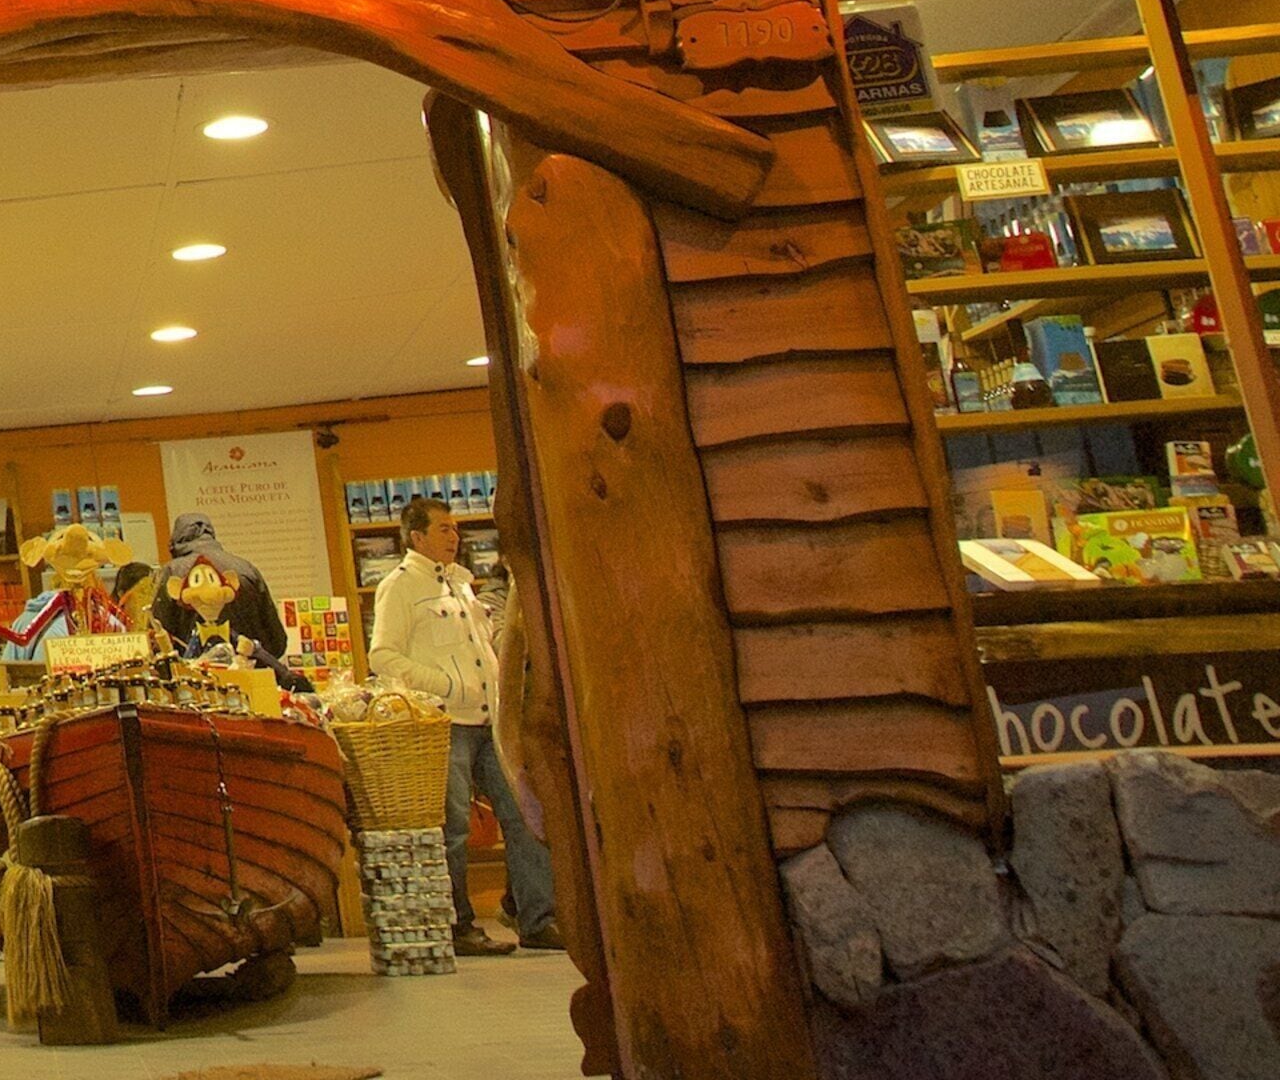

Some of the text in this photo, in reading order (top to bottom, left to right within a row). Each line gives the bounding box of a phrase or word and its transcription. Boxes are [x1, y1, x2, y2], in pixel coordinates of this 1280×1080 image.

[966, 164, 1036, 180] CHOCOLATE
[969, 177, 1040, 193] ARTESANAL
[197, 481, 288, 496] ACEITE PURO DE
[196, 493, 290, 507] ROSA MOSQUETA
